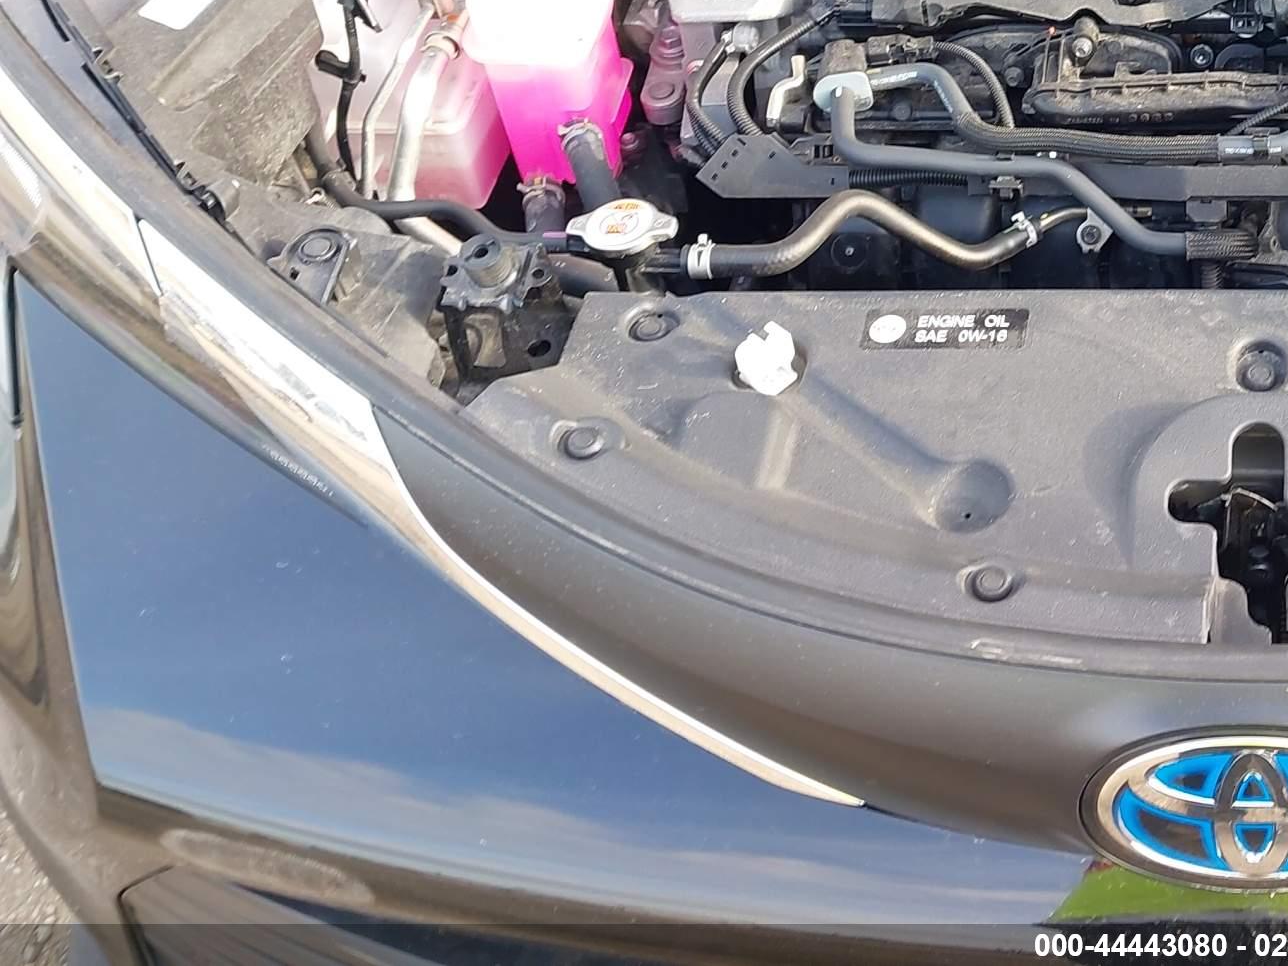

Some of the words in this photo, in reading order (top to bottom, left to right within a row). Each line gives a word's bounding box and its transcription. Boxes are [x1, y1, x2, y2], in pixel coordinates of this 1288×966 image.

[917, 315, 976, 328] ENGINE
[984, 314, 1010, 328] OIL
[914, 330, 948, 343] SAE
